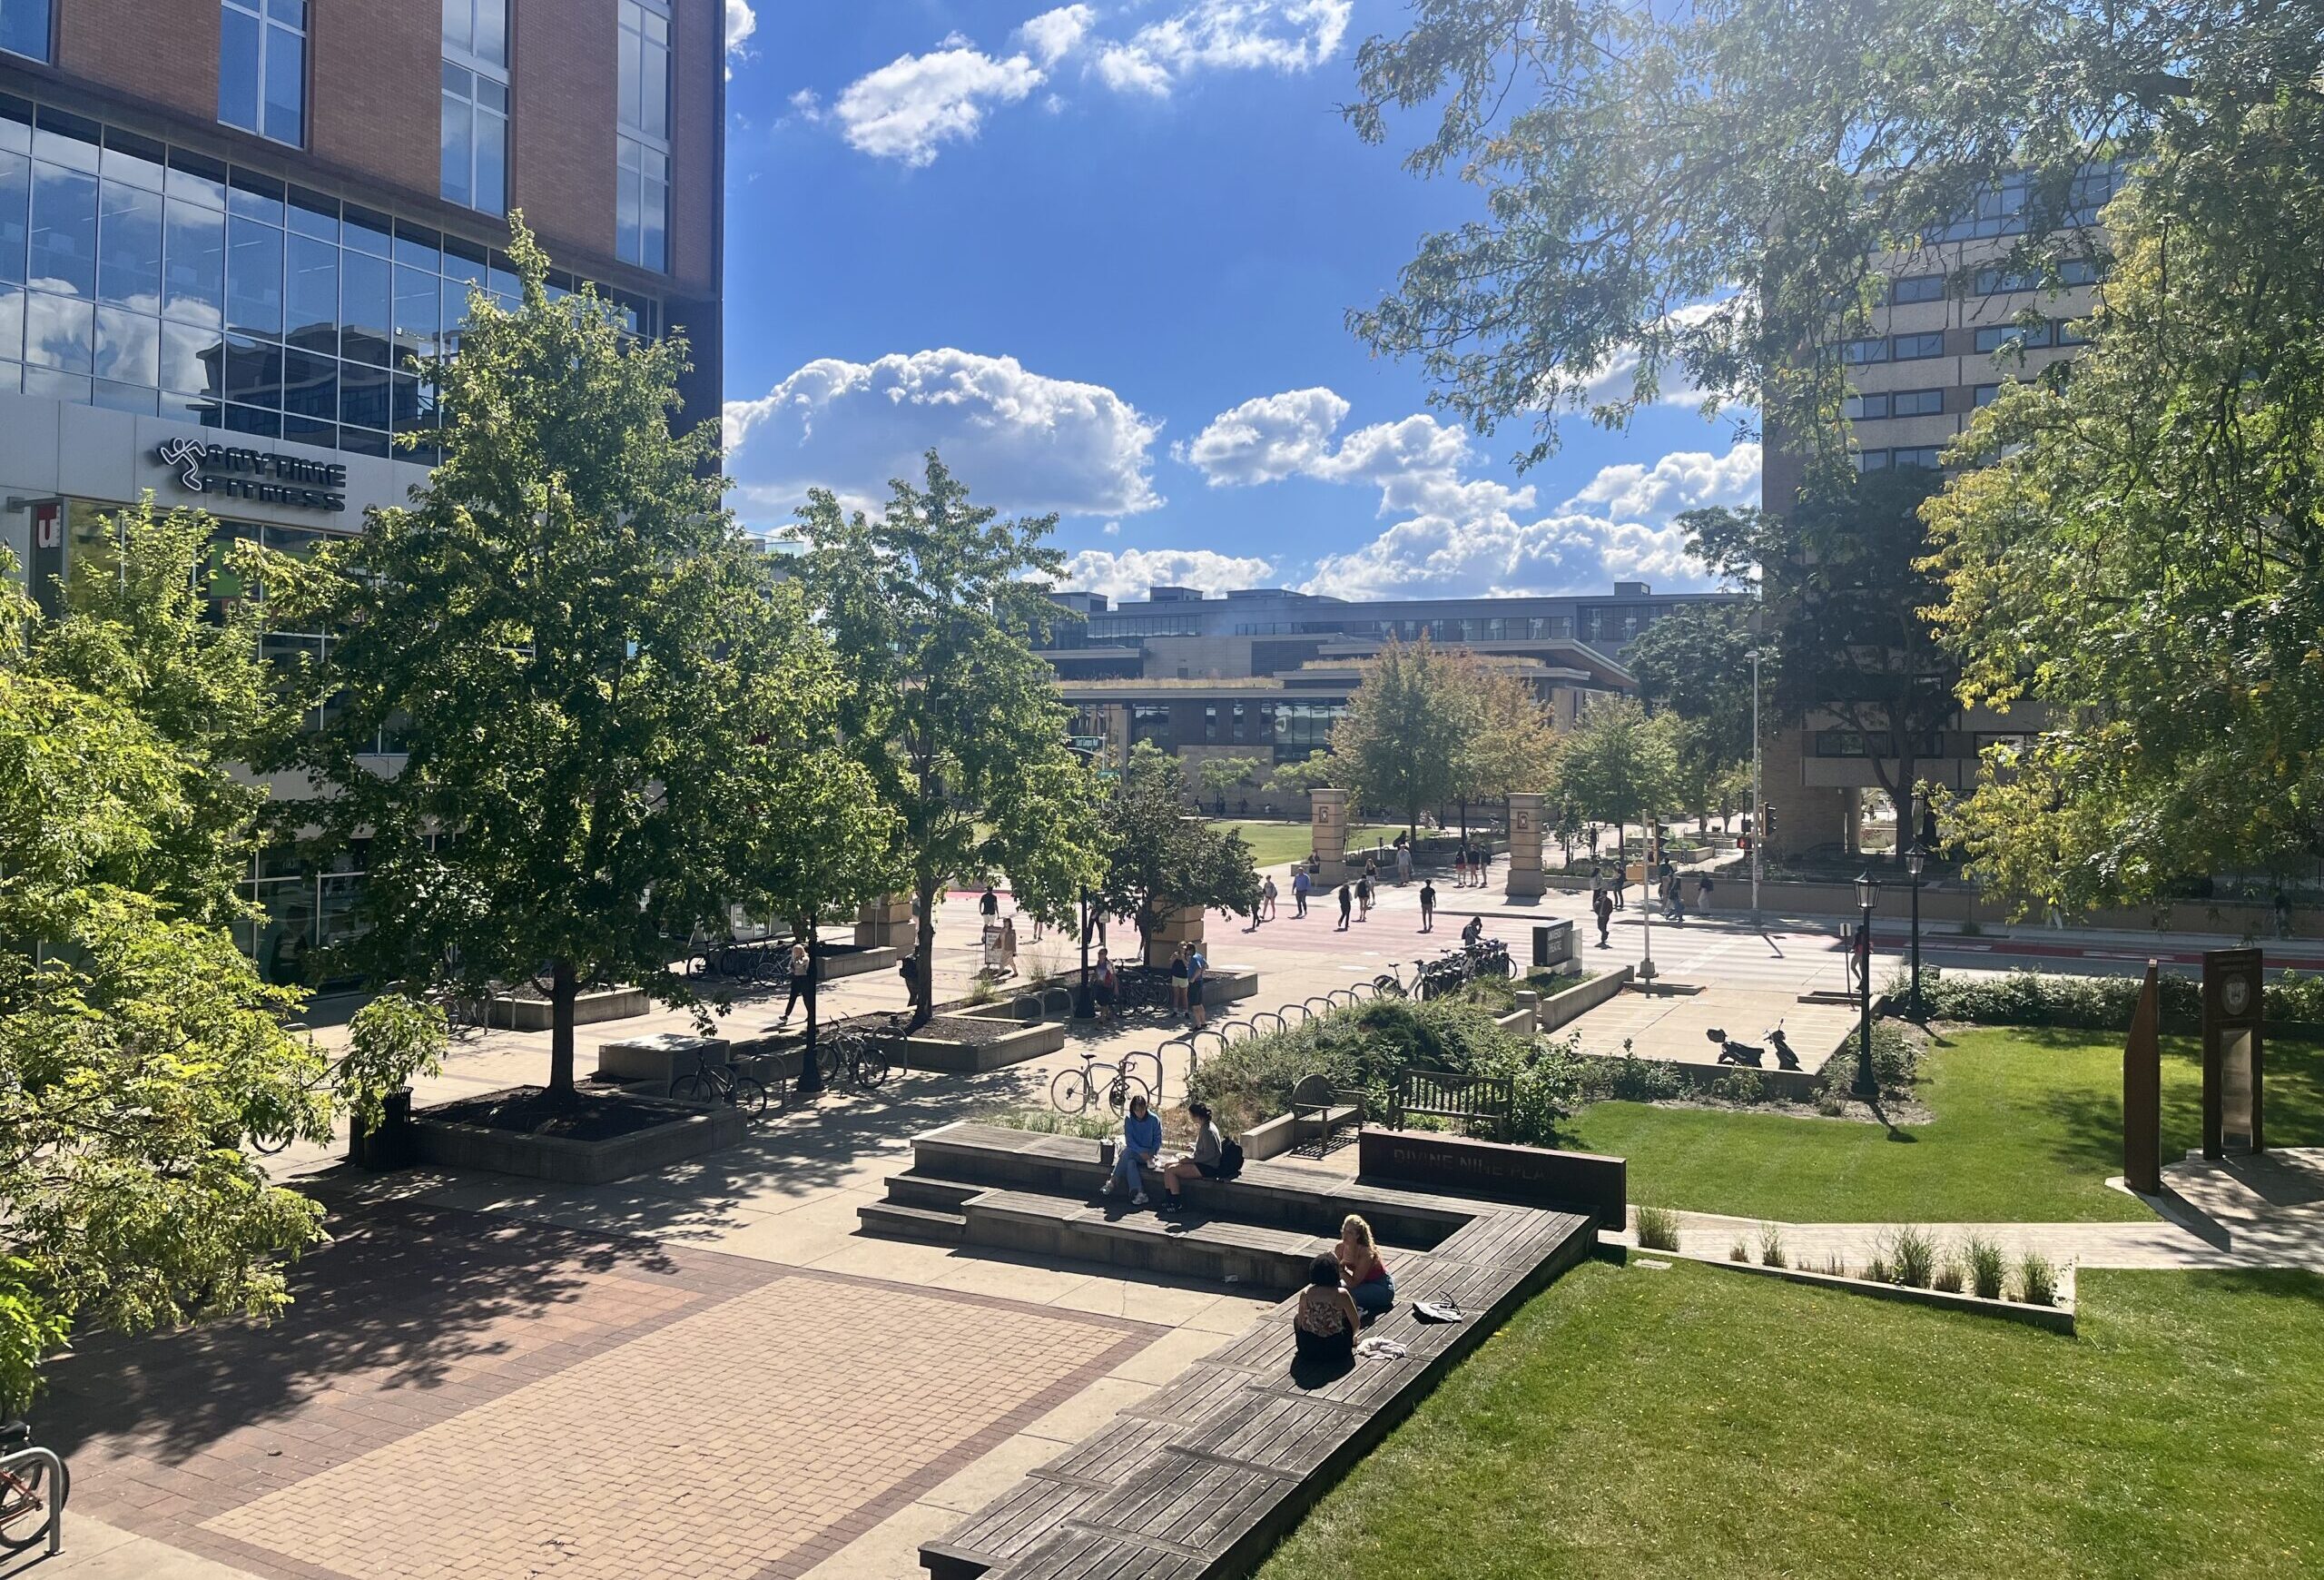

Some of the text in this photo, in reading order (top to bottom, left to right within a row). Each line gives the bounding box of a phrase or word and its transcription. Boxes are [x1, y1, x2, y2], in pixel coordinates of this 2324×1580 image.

[205, 444, 346, 488] ANYTIME
[202, 475, 345, 512] FITNESS
[1547, 927, 1565, 942] UNIVERSITY
[1393, 1149, 1452, 1170] DIVINE
